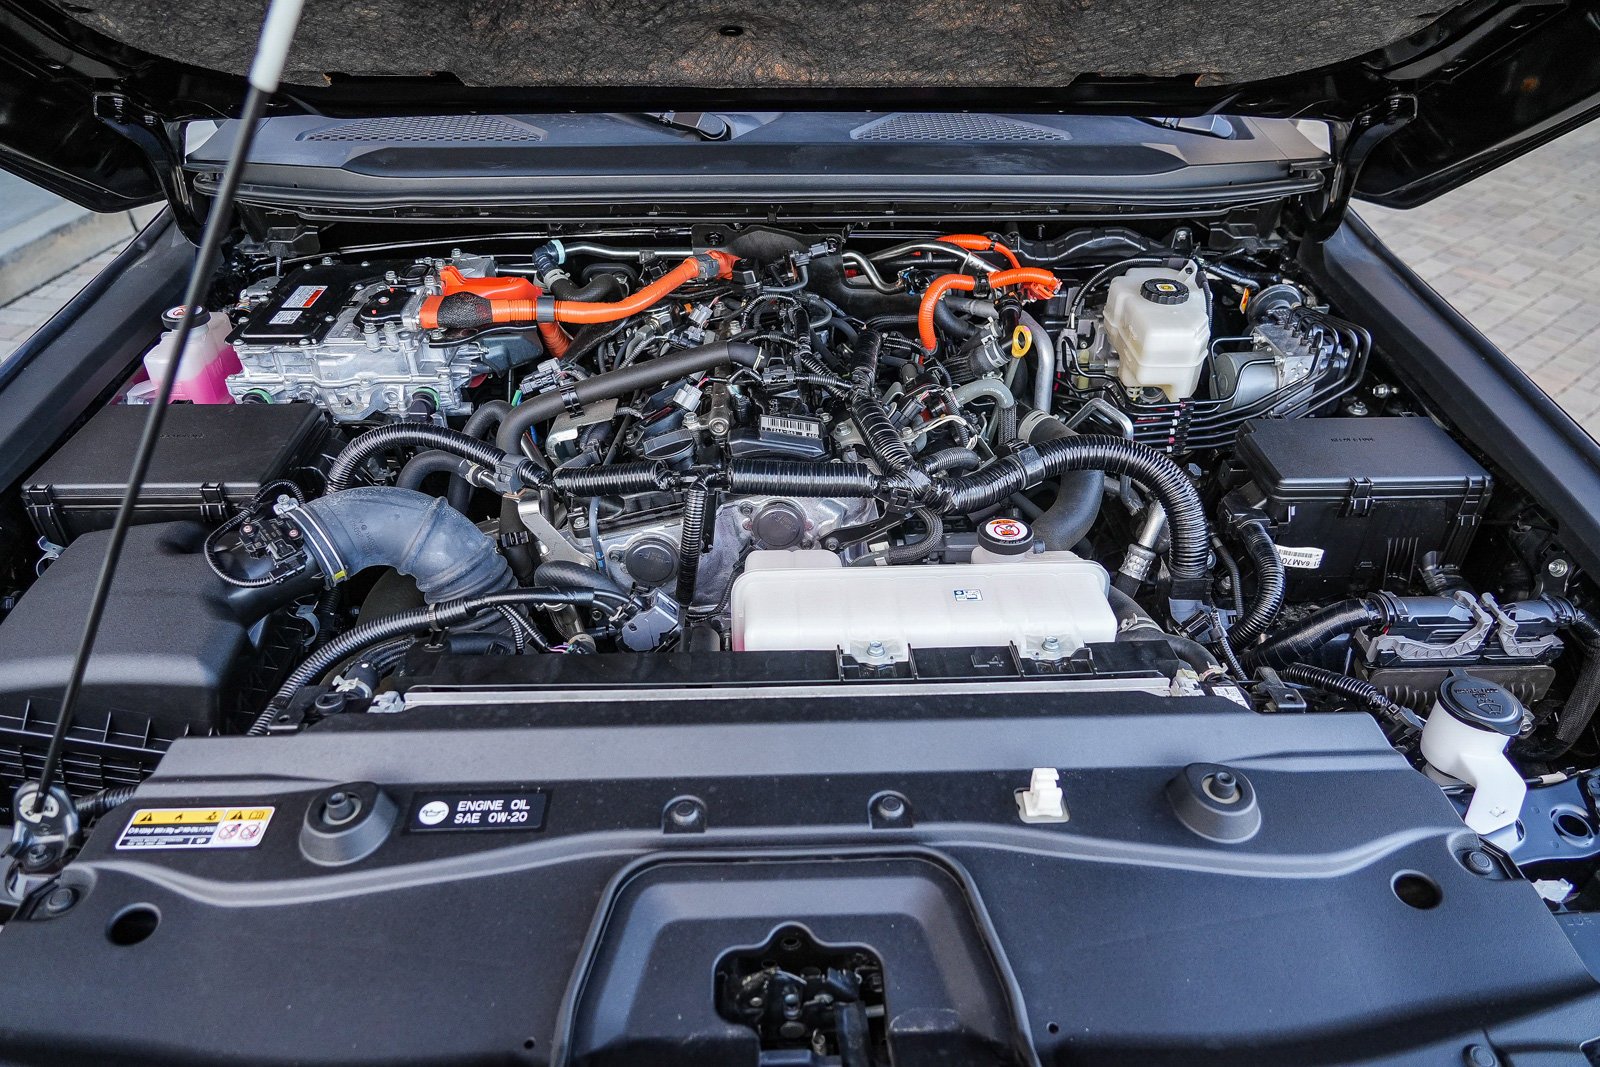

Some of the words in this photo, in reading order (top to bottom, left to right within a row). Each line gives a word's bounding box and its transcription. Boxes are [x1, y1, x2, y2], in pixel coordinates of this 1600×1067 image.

[457, 800, 504, 811] ENGINE
[511, 800, 530, 810] OIL
[454, 813, 481, 824] SAE
[488, 812, 528, 823] 0W-20
